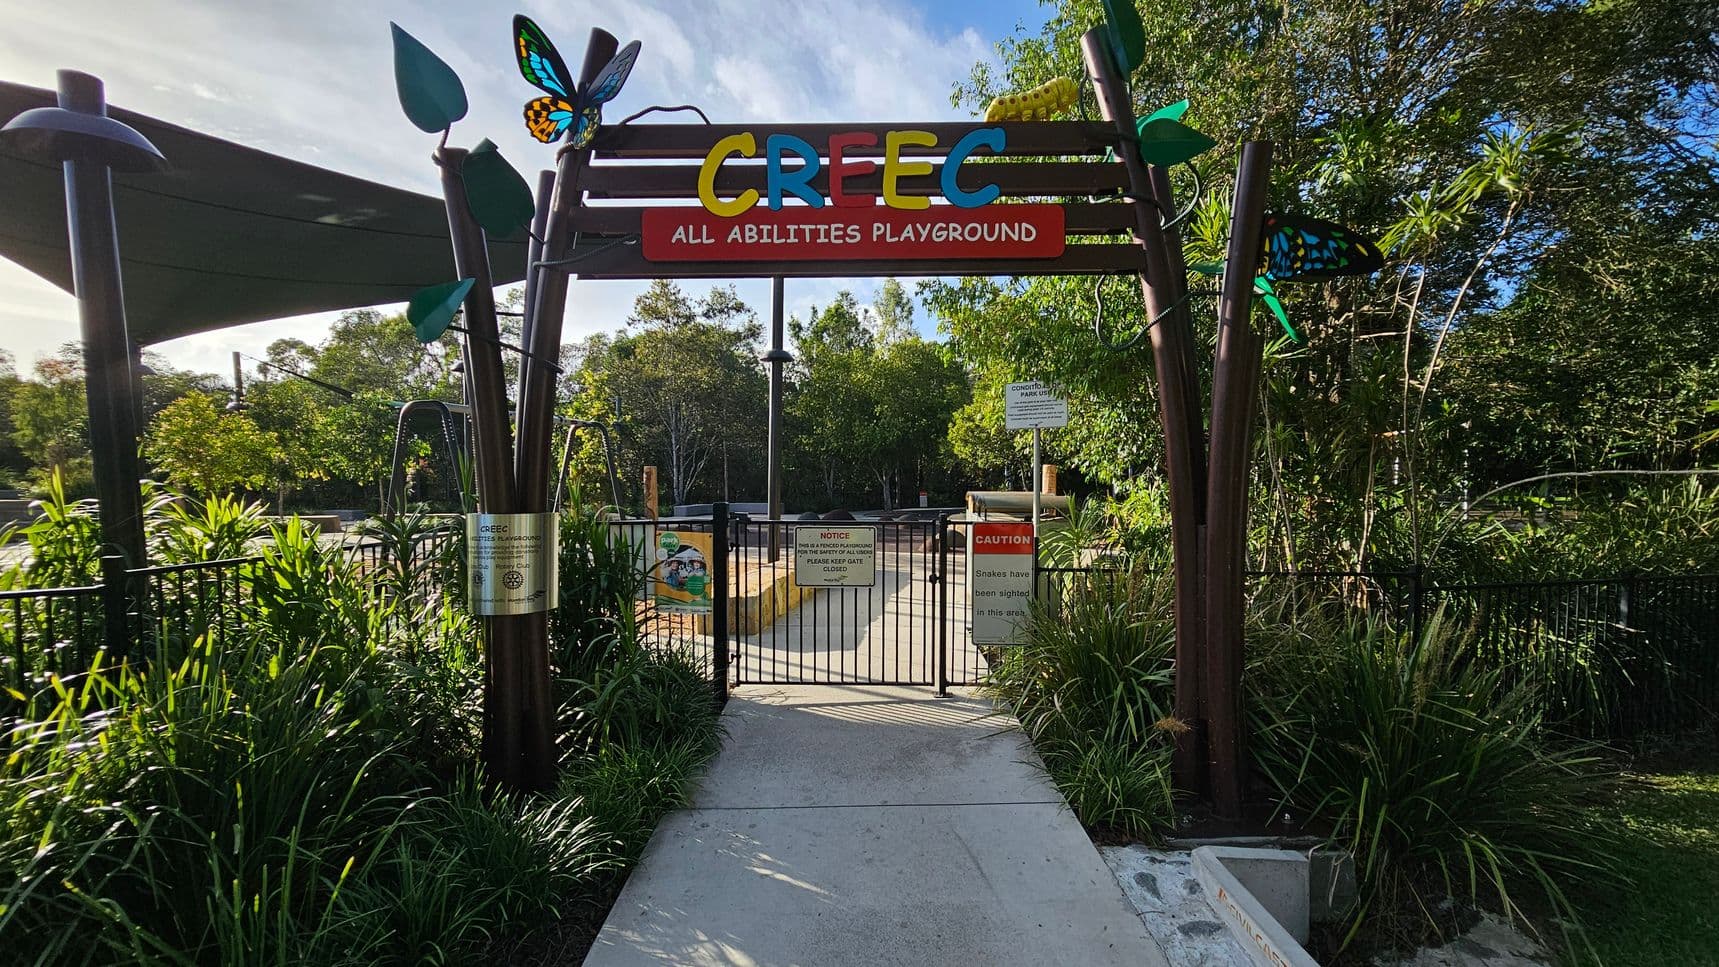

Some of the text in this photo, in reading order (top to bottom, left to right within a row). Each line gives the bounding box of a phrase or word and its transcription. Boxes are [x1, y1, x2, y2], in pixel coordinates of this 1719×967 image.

[698, 127, 1006, 217] CREEC
[671, 222, 1037, 245] ALL ABILITIES PLAYGROUND
[480, 525, 508, 533] CREEC
[820, 532, 850, 540] NOTICE
[975, 535, 1031, 545] CAUTION
[975, 570, 1030, 578] Snakes have
[999, 589, 1030, 599] sighted
